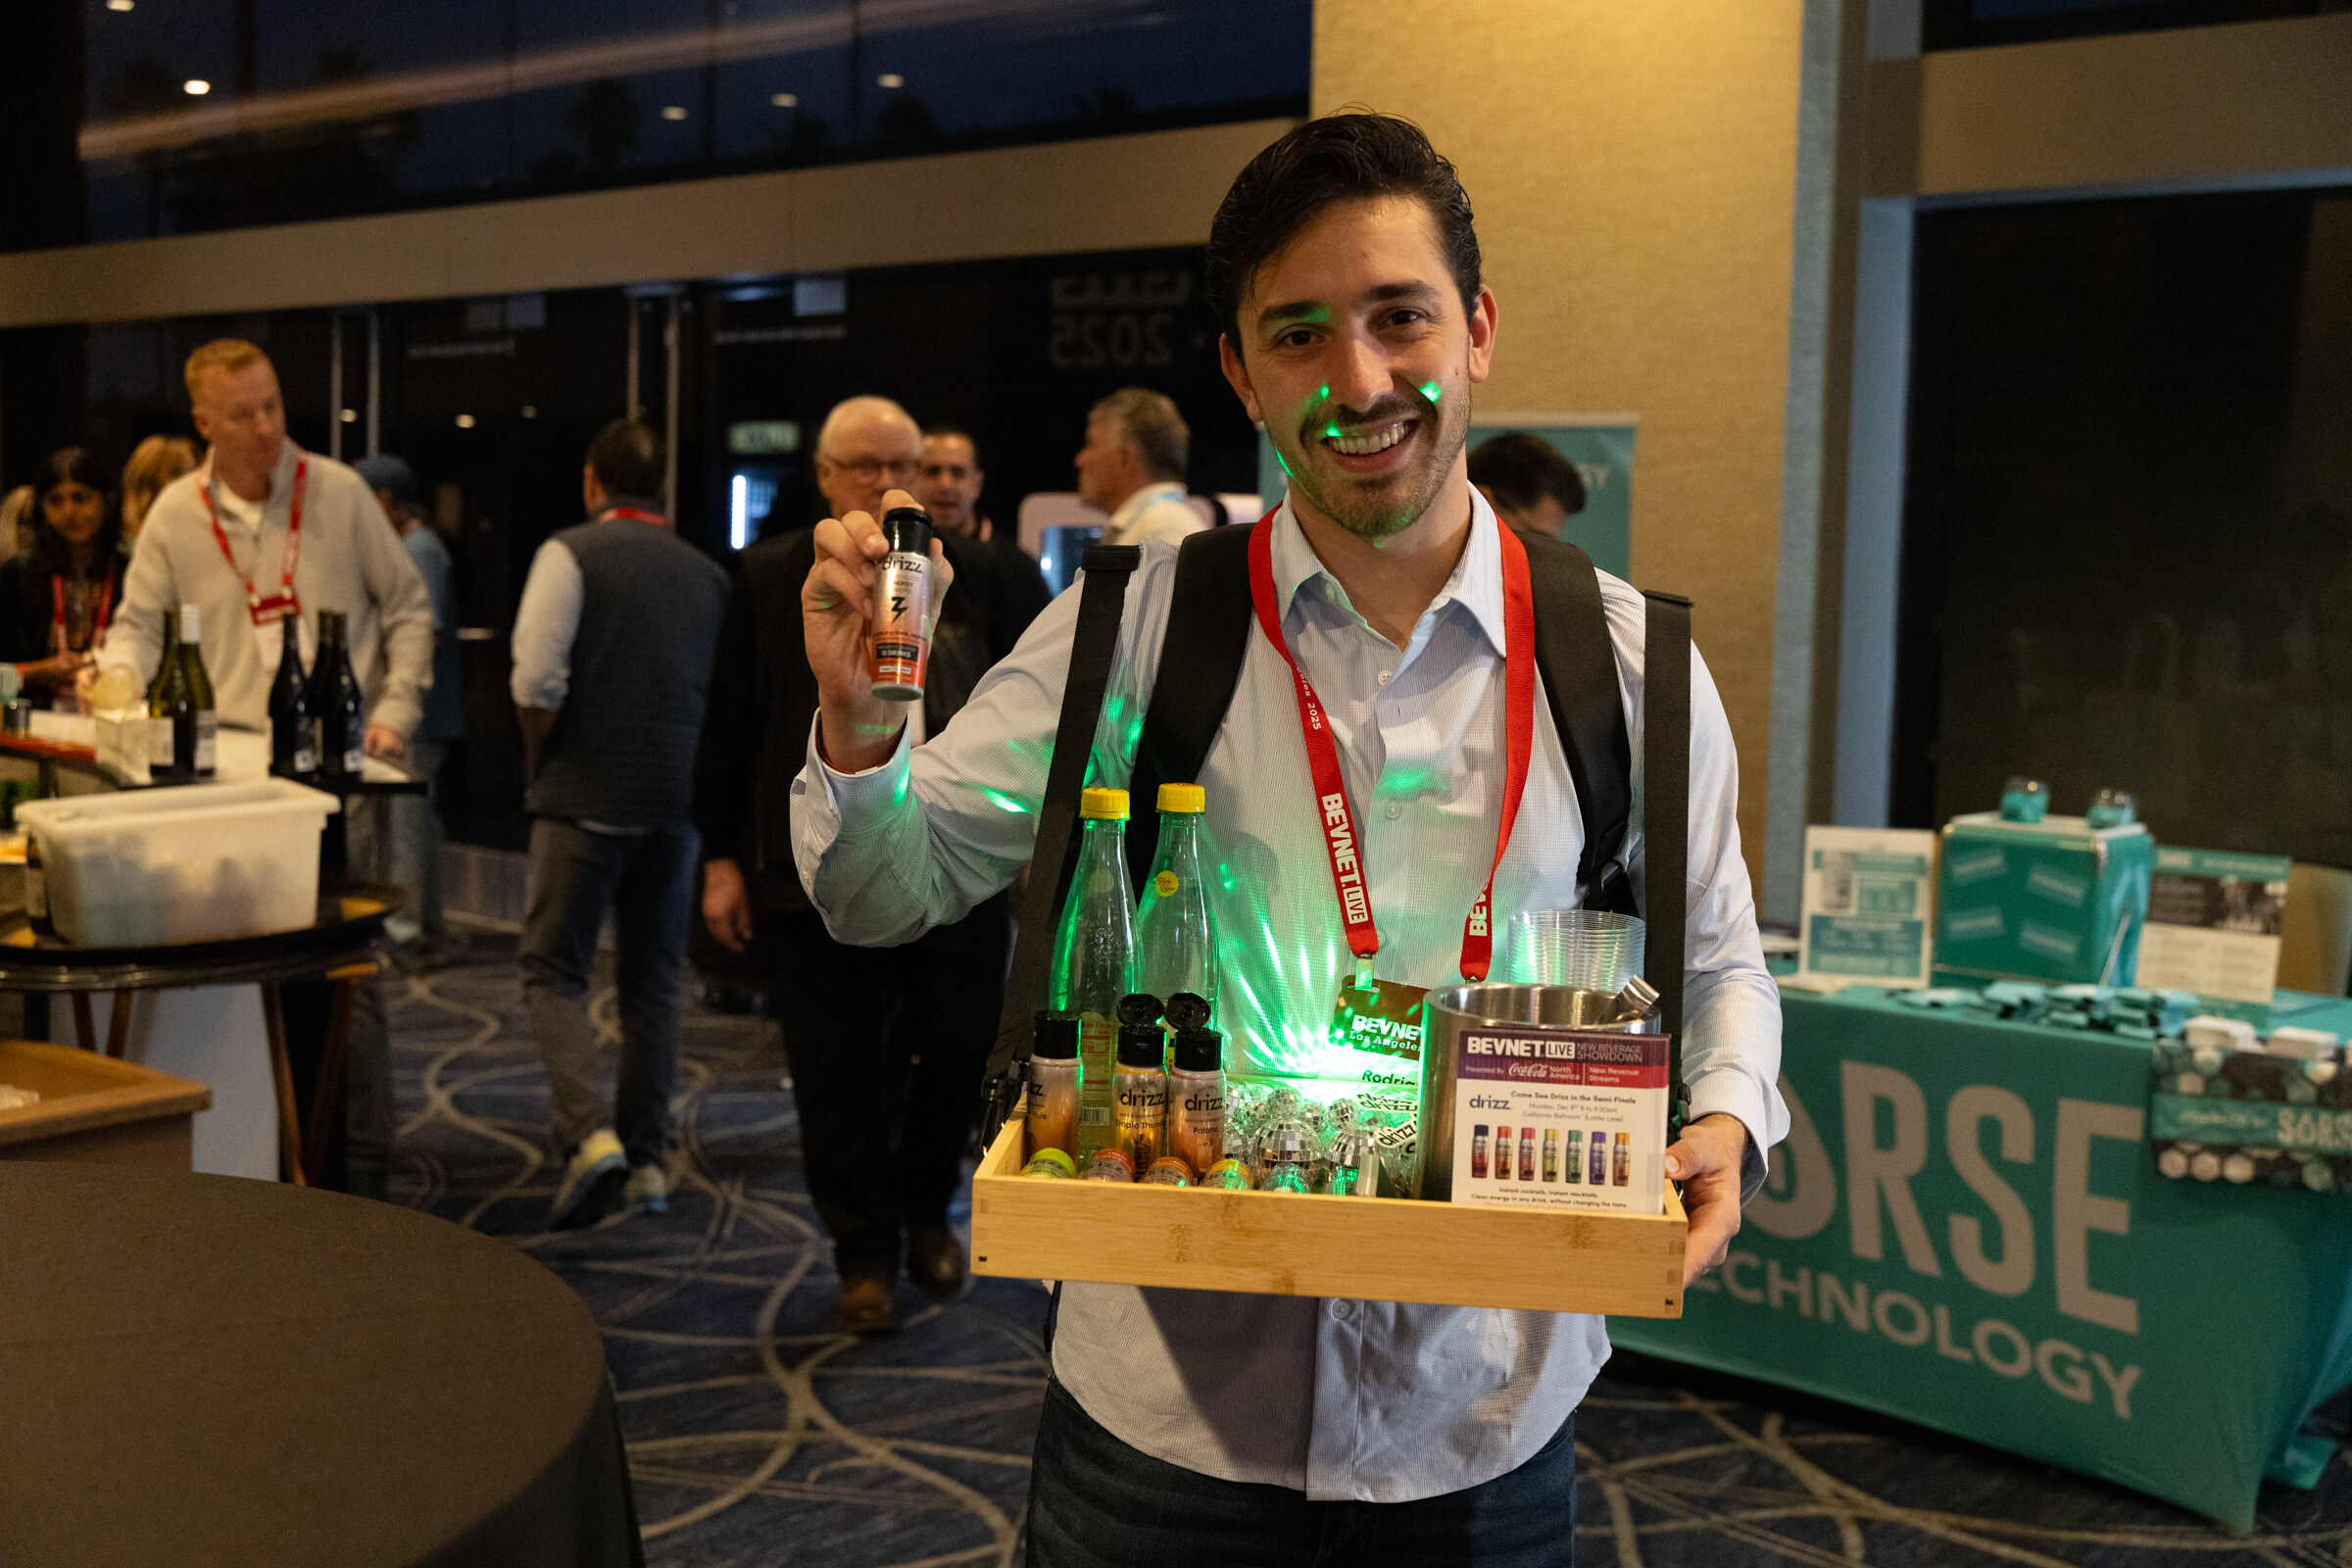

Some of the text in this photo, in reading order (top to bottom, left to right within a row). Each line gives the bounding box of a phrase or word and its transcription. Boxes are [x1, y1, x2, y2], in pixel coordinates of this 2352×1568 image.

[883, 556, 922, 573] drizz
[1307, 702, 1322, 730] 2025
[1346, 887, 1366, 921] LIVE
[1469, 882, 1488, 937] BEV
[1351, 1014, 1422, 1041] BEVNE
[1349, 1031, 1370, 1043] Los
[1467, 1037, 1573, 1057] BEVNET LIVE
[1598, 1044, 1642, 1053] BEVERAGE
[1577, 1051, 1642, 1062] SHOWDOWN
[1361, 1070, 1416, 1086] Rodri
[1120, 1089, 1165, 1106] drizz
[1185, 1094, 1223, 1111] drizz
[1470, 1095, 1510, 1109] drizz
[2278, 1106, 2352, 1152] SORS
[1740, 1059, 2145, 1336] ORSE
[1693, 1250, 2141, 1420] CHNOLOGY
